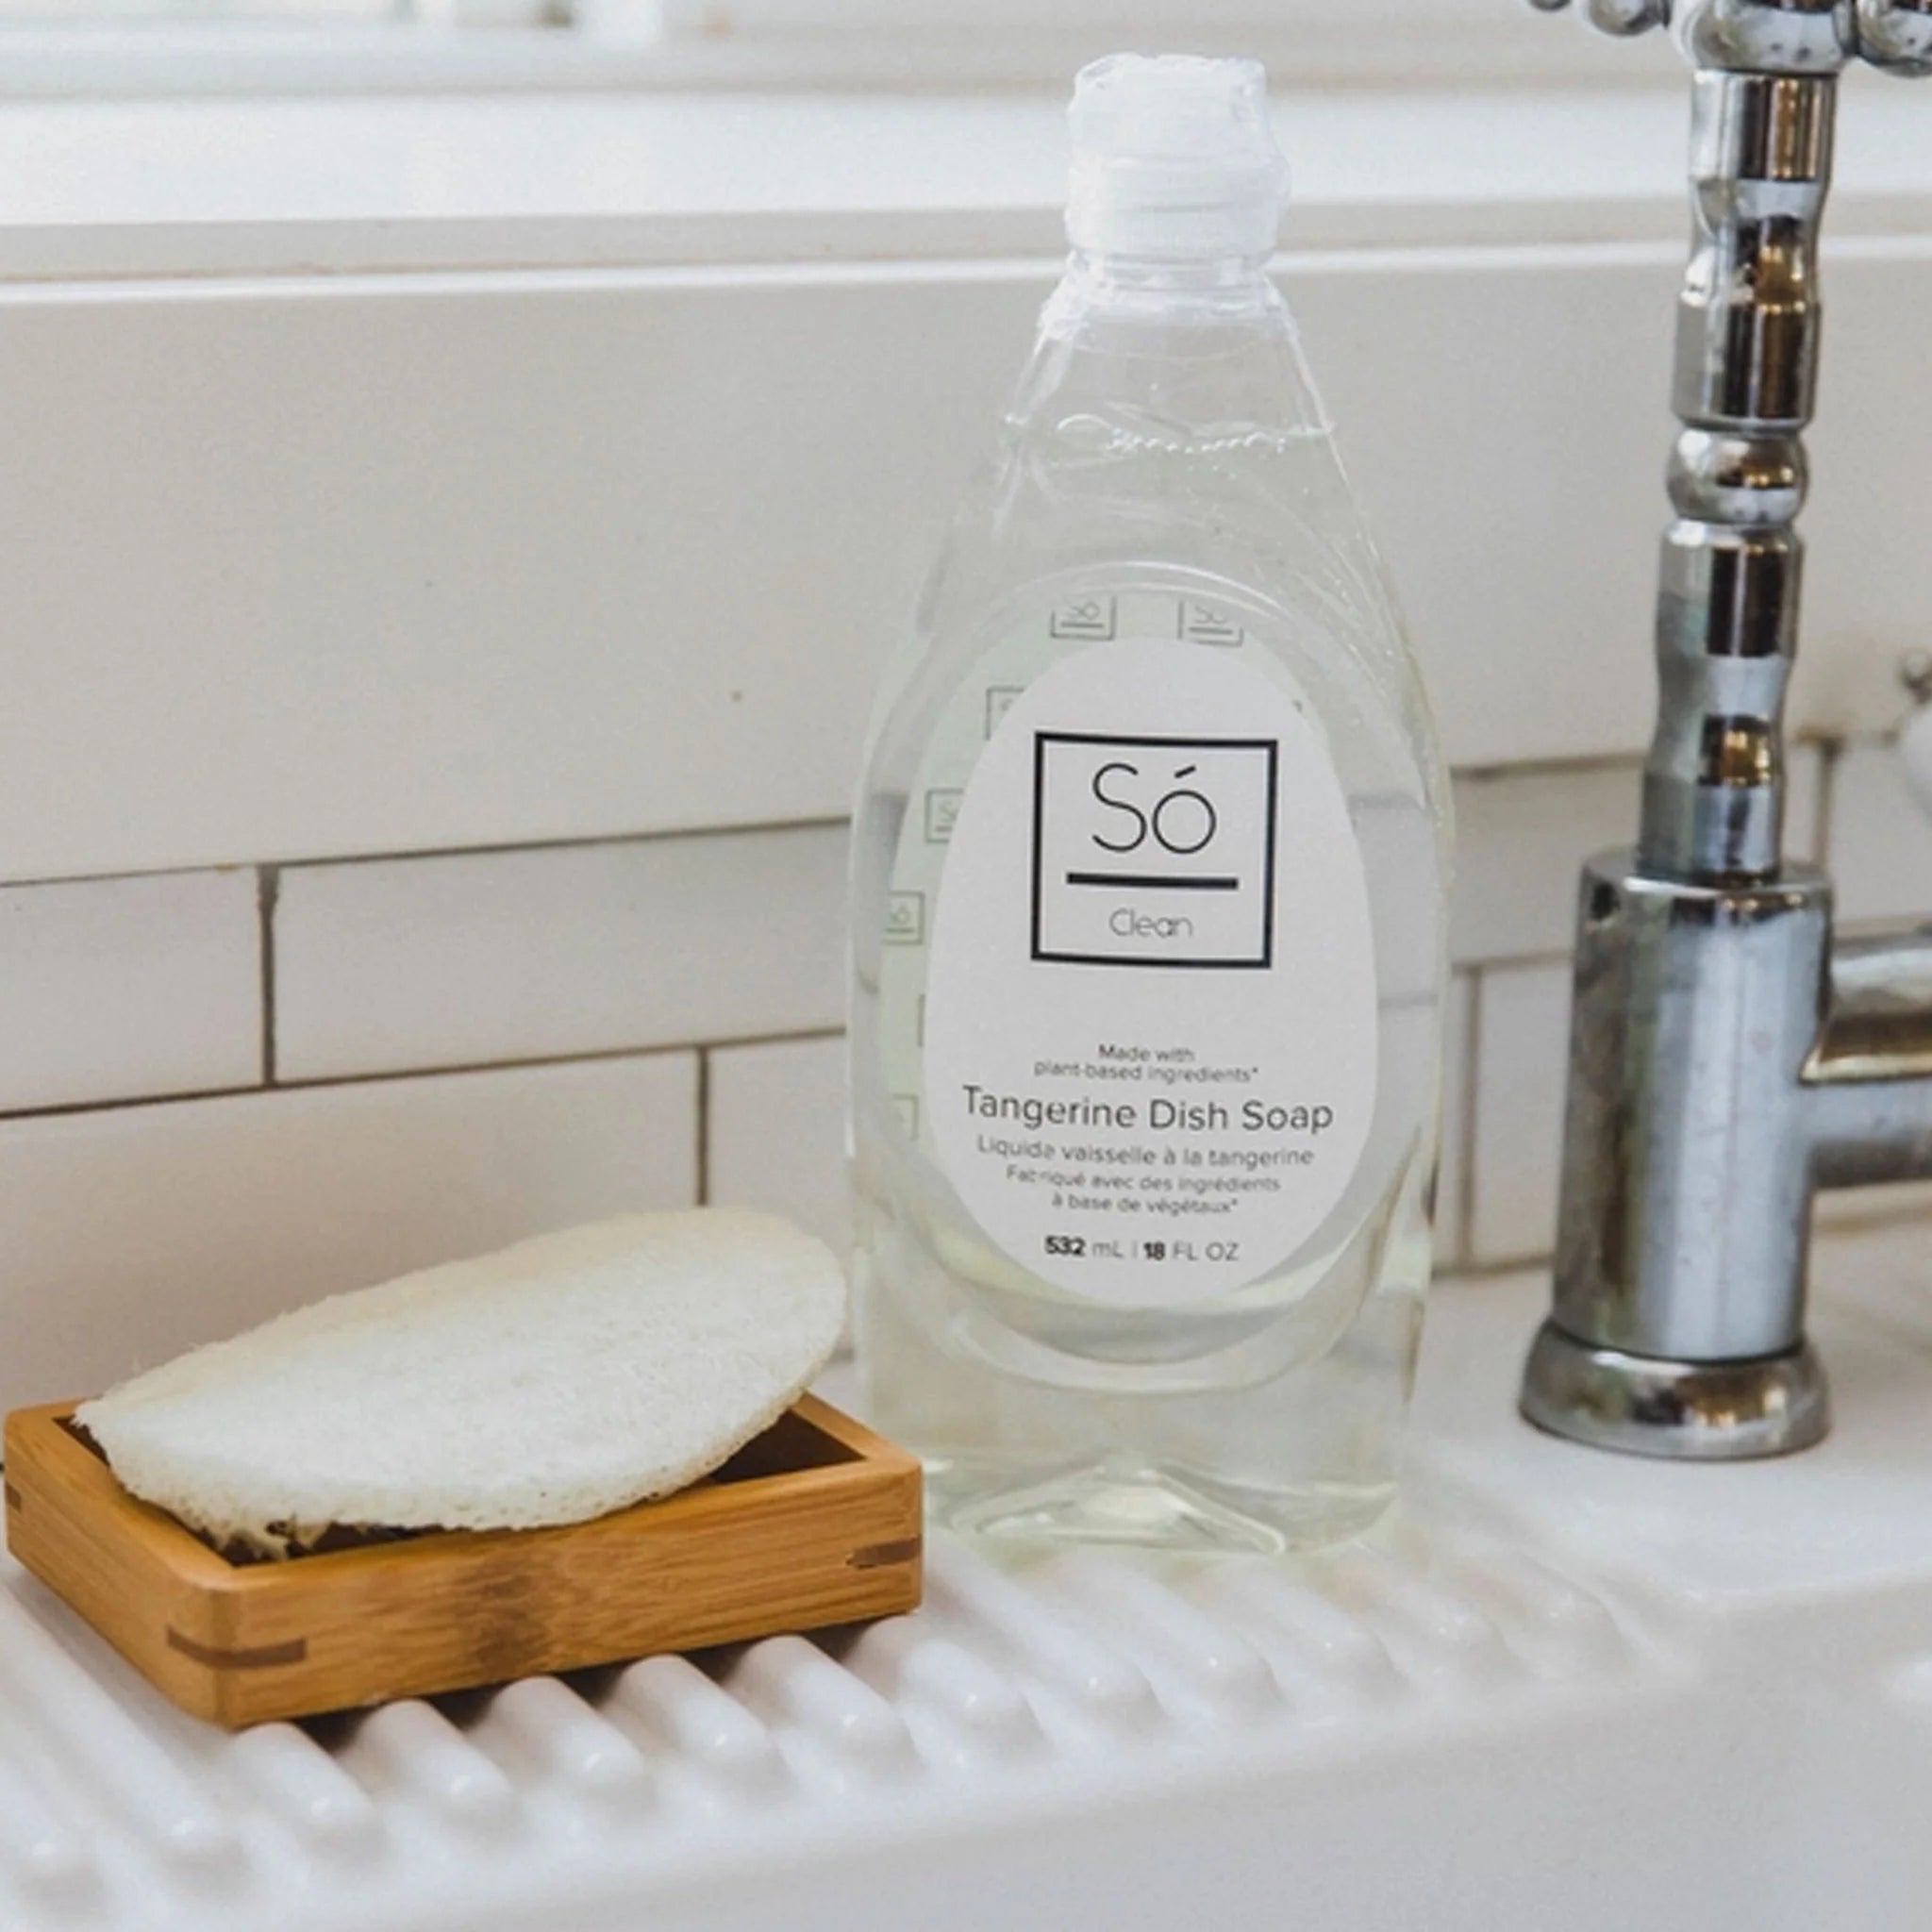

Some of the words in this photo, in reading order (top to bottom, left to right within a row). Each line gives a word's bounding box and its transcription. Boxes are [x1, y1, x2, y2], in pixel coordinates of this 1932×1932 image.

[1091, 761, 1217, 854] Só
[1108, 908, 1193, 938] Clean
[1098, 1042, 1151, 1062] Made
[1155, 1047, 1195, 1063] with
[1033, 1059, 1142, 1081] plant-based
[961, 1083, 1137, 1130] Tangerine
[1149, 1097, 1229, 1132] Dish
[1241, 1099, 1334, 1135] Soap
[976, 1134, 1056, 1159] Liquide
[1060, 1143, 1158, 1164] vaisselle
[1163, 1148, 1177, 1166] à
[1184, 1148, 1204, 1167] la
[1208, 1148, 1316, 1172] tangerine
[1006, 1163, 1087, 1188] Fabriqué
[1091, 1173, 1135, 1191] avec
[1139, 1176, 1174, 1191] des
[1178, 1176, 1282, 1195] ingrédients
[1051, 1191, 1063, 1208] à
[1067, 1193, 1113, 1211] base
[1116, 1196, 1141, 1213] de
[1044, 1234, 1087, 1257] 532
[1091, 1240, 1124, 1258] mL
[1142, 1241, 1167, 1261] 18
[1173, 1241, 1199, 1261] FL
[1205, 1241, 1240, 1262] OZ
